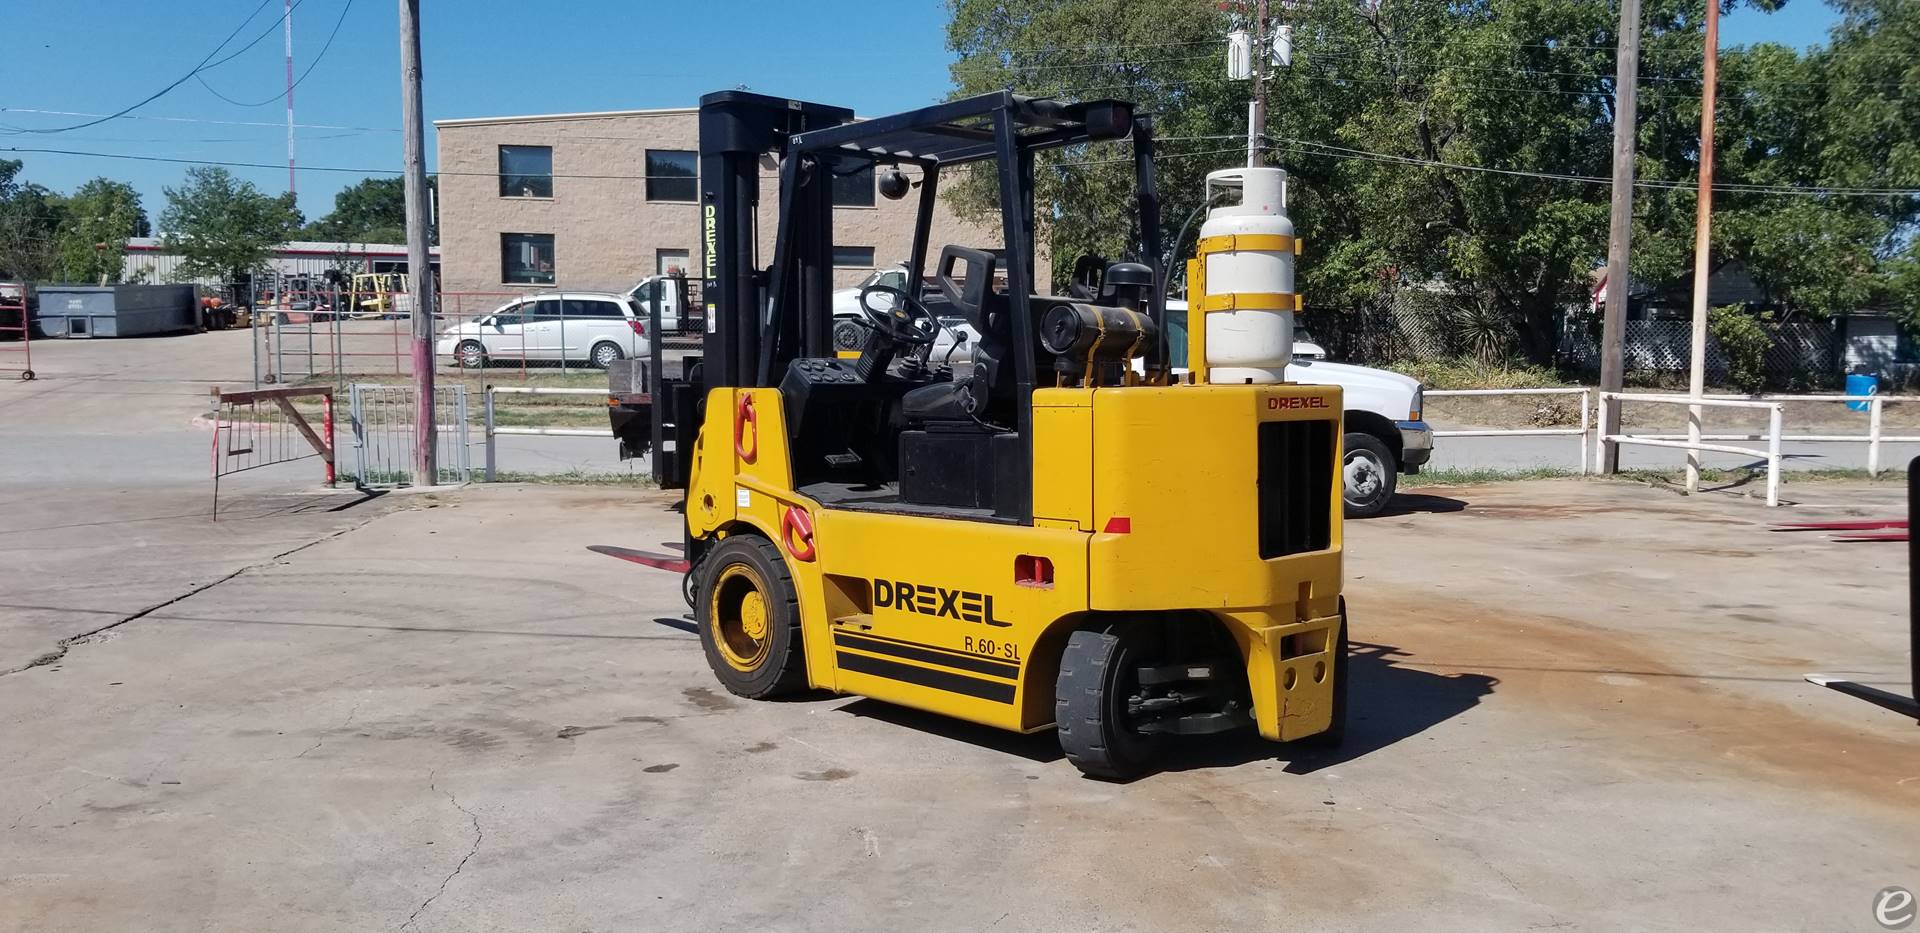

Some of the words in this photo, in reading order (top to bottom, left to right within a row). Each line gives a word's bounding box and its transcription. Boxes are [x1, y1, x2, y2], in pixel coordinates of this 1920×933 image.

[705, 205, 717, 279] DREXEL
[1268, 396, 1329, 409] DREXEL
[874, 578, 1012, 627] DREXEL
